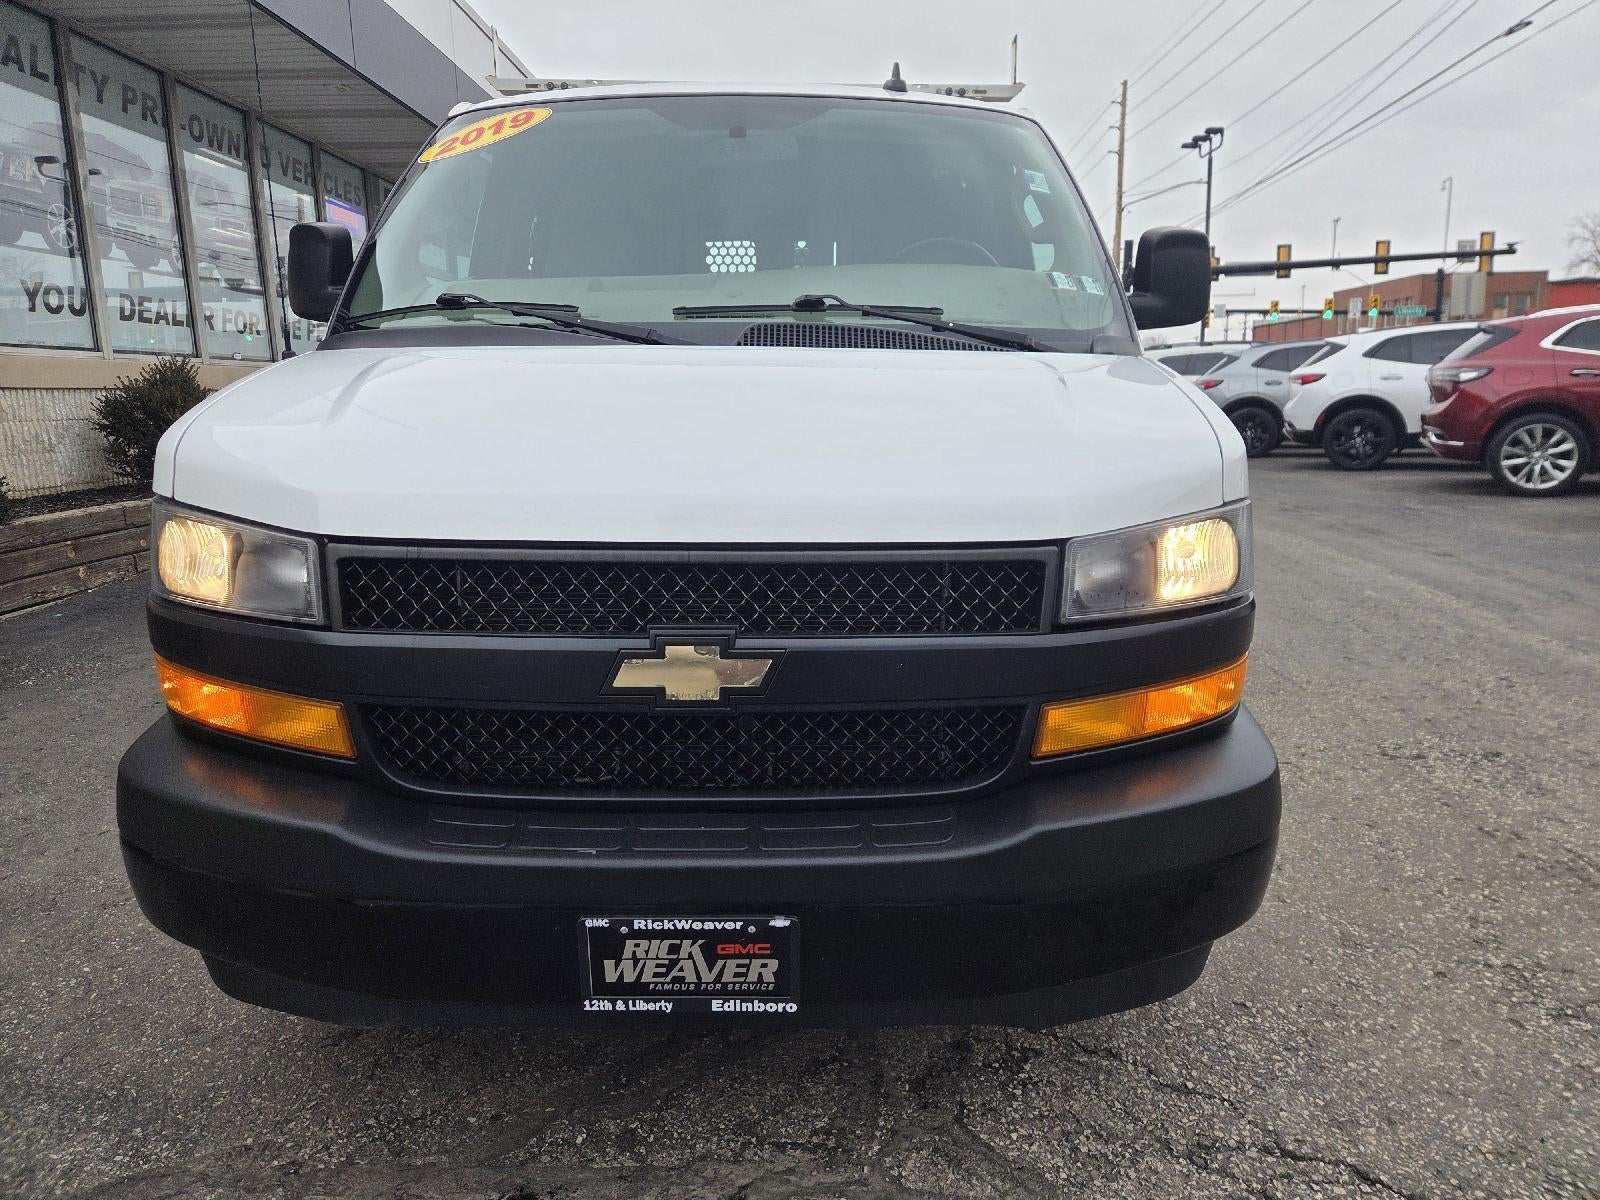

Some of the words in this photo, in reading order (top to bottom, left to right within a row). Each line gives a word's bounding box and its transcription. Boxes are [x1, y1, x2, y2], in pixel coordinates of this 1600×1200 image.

[434, 111, 536, 157] 2019
[222, 307, 262, 337] FOR
[584, 918, 610, 928] GMC
[622, 939, 706, 960] RICK
[716, 943, 771, 955] GMC
[603, 958, 779, 983] WEAVER
[649, 983, 695, 991] FAMOUS
[700, 983, 722, 991] FOR
[727, 983, 775, 991] SERVICE
[583, 999, 613, 1011] 12th
[615, 999, 627, 1011] &
[628, 999, 673, 1013] Liberty
[711, 999, 798, 1013] Edinboro
